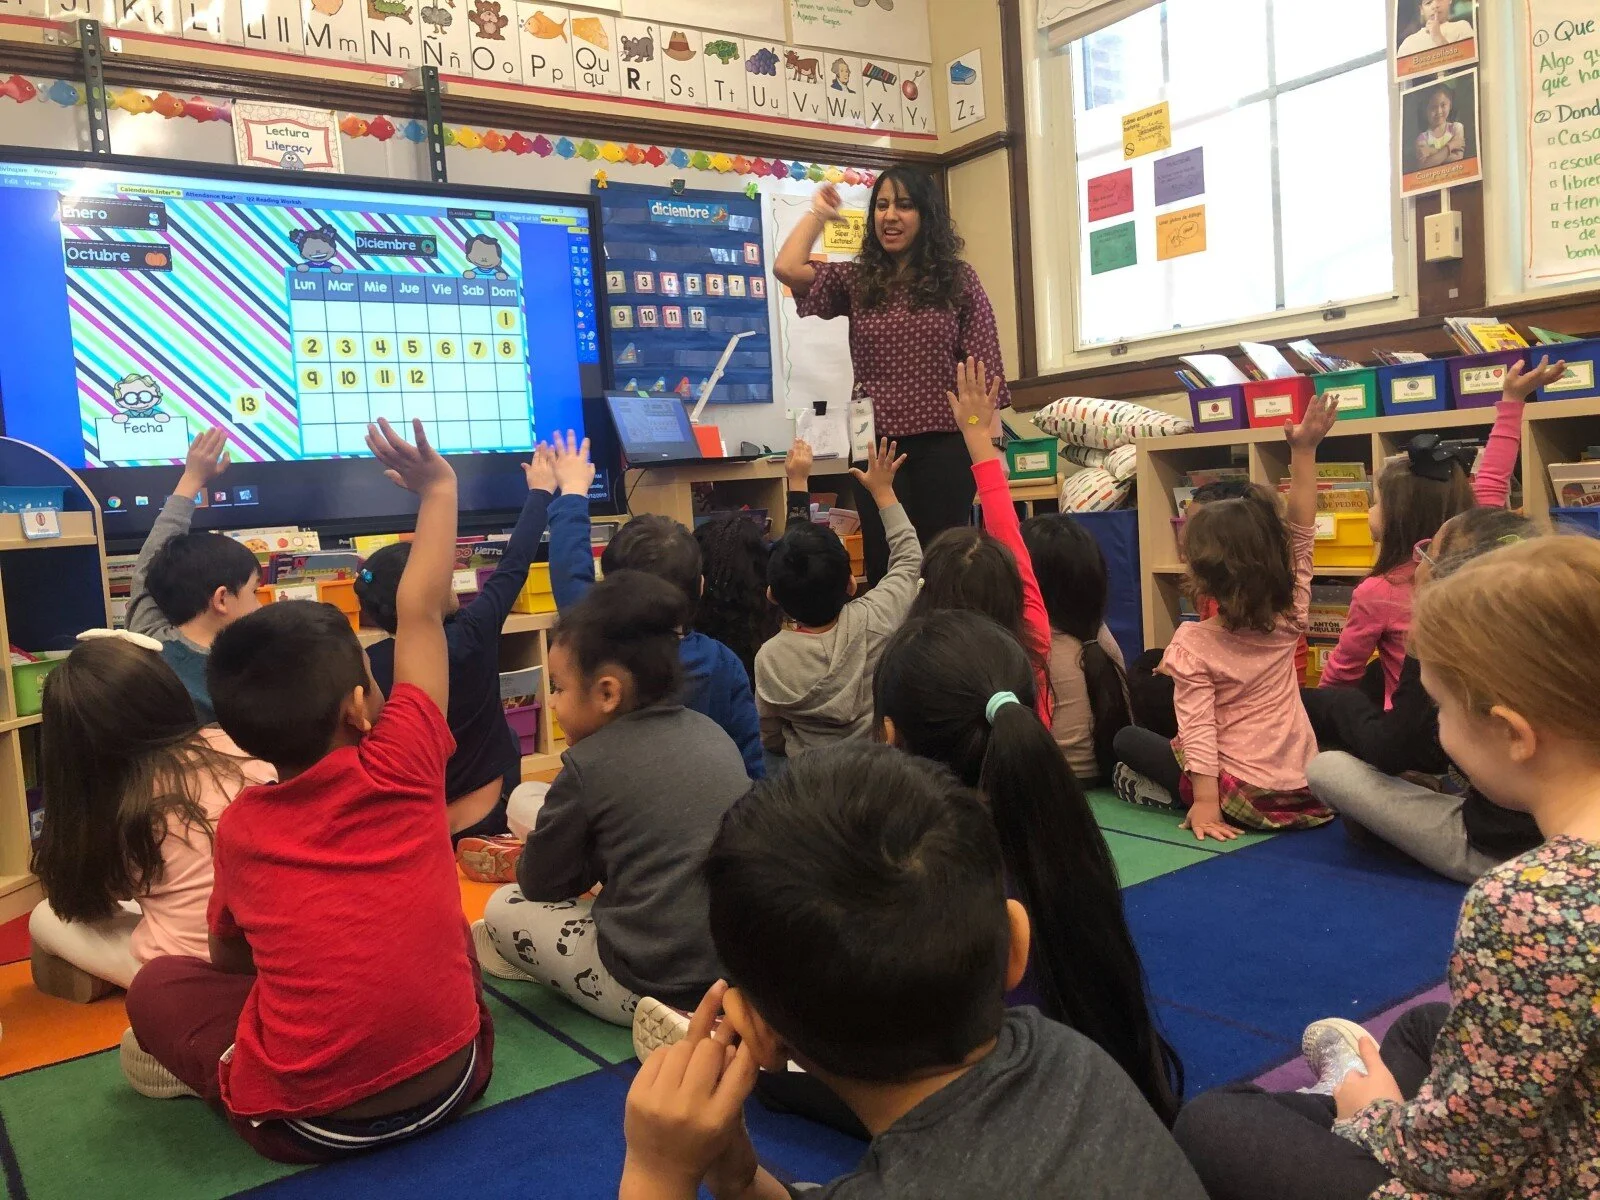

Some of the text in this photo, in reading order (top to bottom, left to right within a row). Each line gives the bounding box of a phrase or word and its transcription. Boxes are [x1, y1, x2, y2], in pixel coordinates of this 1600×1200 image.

[123, 0, 165, 25] K k
[305, 23, 357, 52] M m
[1554, 20, 1595, 41] Que
[371, 30, 411, 59] N n
[423, 35, 461, 68] Ñ ñ
[472, 46, 515, 74] O o
[531, 54, 564, 84] P p
[575, 47, 610, 73] Qu
[1540, 51, 1574, 76] Algo
[583, 69, 605, 88] qu
[627, 67, 651, 92] R r
[670, 74, 695, 98] S s
[1541, 76, 1572, 97] que
[713, 79, 735, 103] T t
[752, 86, 779, 110] U u
[792, 91, 819, 115] V v
[827, 96, 861, 121] W w
[956, 100, 976, 121] Z z
[871, 102, 895, 124] X x
[906, 106, 928, 129] Y y
[265, 125, 310, 139] Lectura
[265, 140, 313, 155] Literacy
[120, 186, 154, 195] Calendario
[185, 191, 220, 200] Attendance
[256, 197, 280, 205] Reading
[651, 201, 710, 220] diciembre
[62, 207, 108, 220] Enero
[356, 236, 416, 251] Diciembre
[1578, 228, 1597, 241] de
[67, 247, 131, 263] Octubre
[750, 248, 755, 258] 1
[294, 279, 517, 298] Lun Mar Mie Jue Vie Sab Dom
[611, 276, 761, 292] 2 3 4 5 6 7 8
[503, 312, 509, 326] 1
[618, 311, 703, 322] 9 10 11 12
[307, 339, 512, 355] 2 3 4 5 6 7 8
[307, 370, 424, 386] 9 10 11 12
[240, 397, 256, 412] 13
[123, 422, 164, 434] Fecha
[474, 546, 503, 555] tierra
[1313, 620, 1340, 628] ANTÓN
